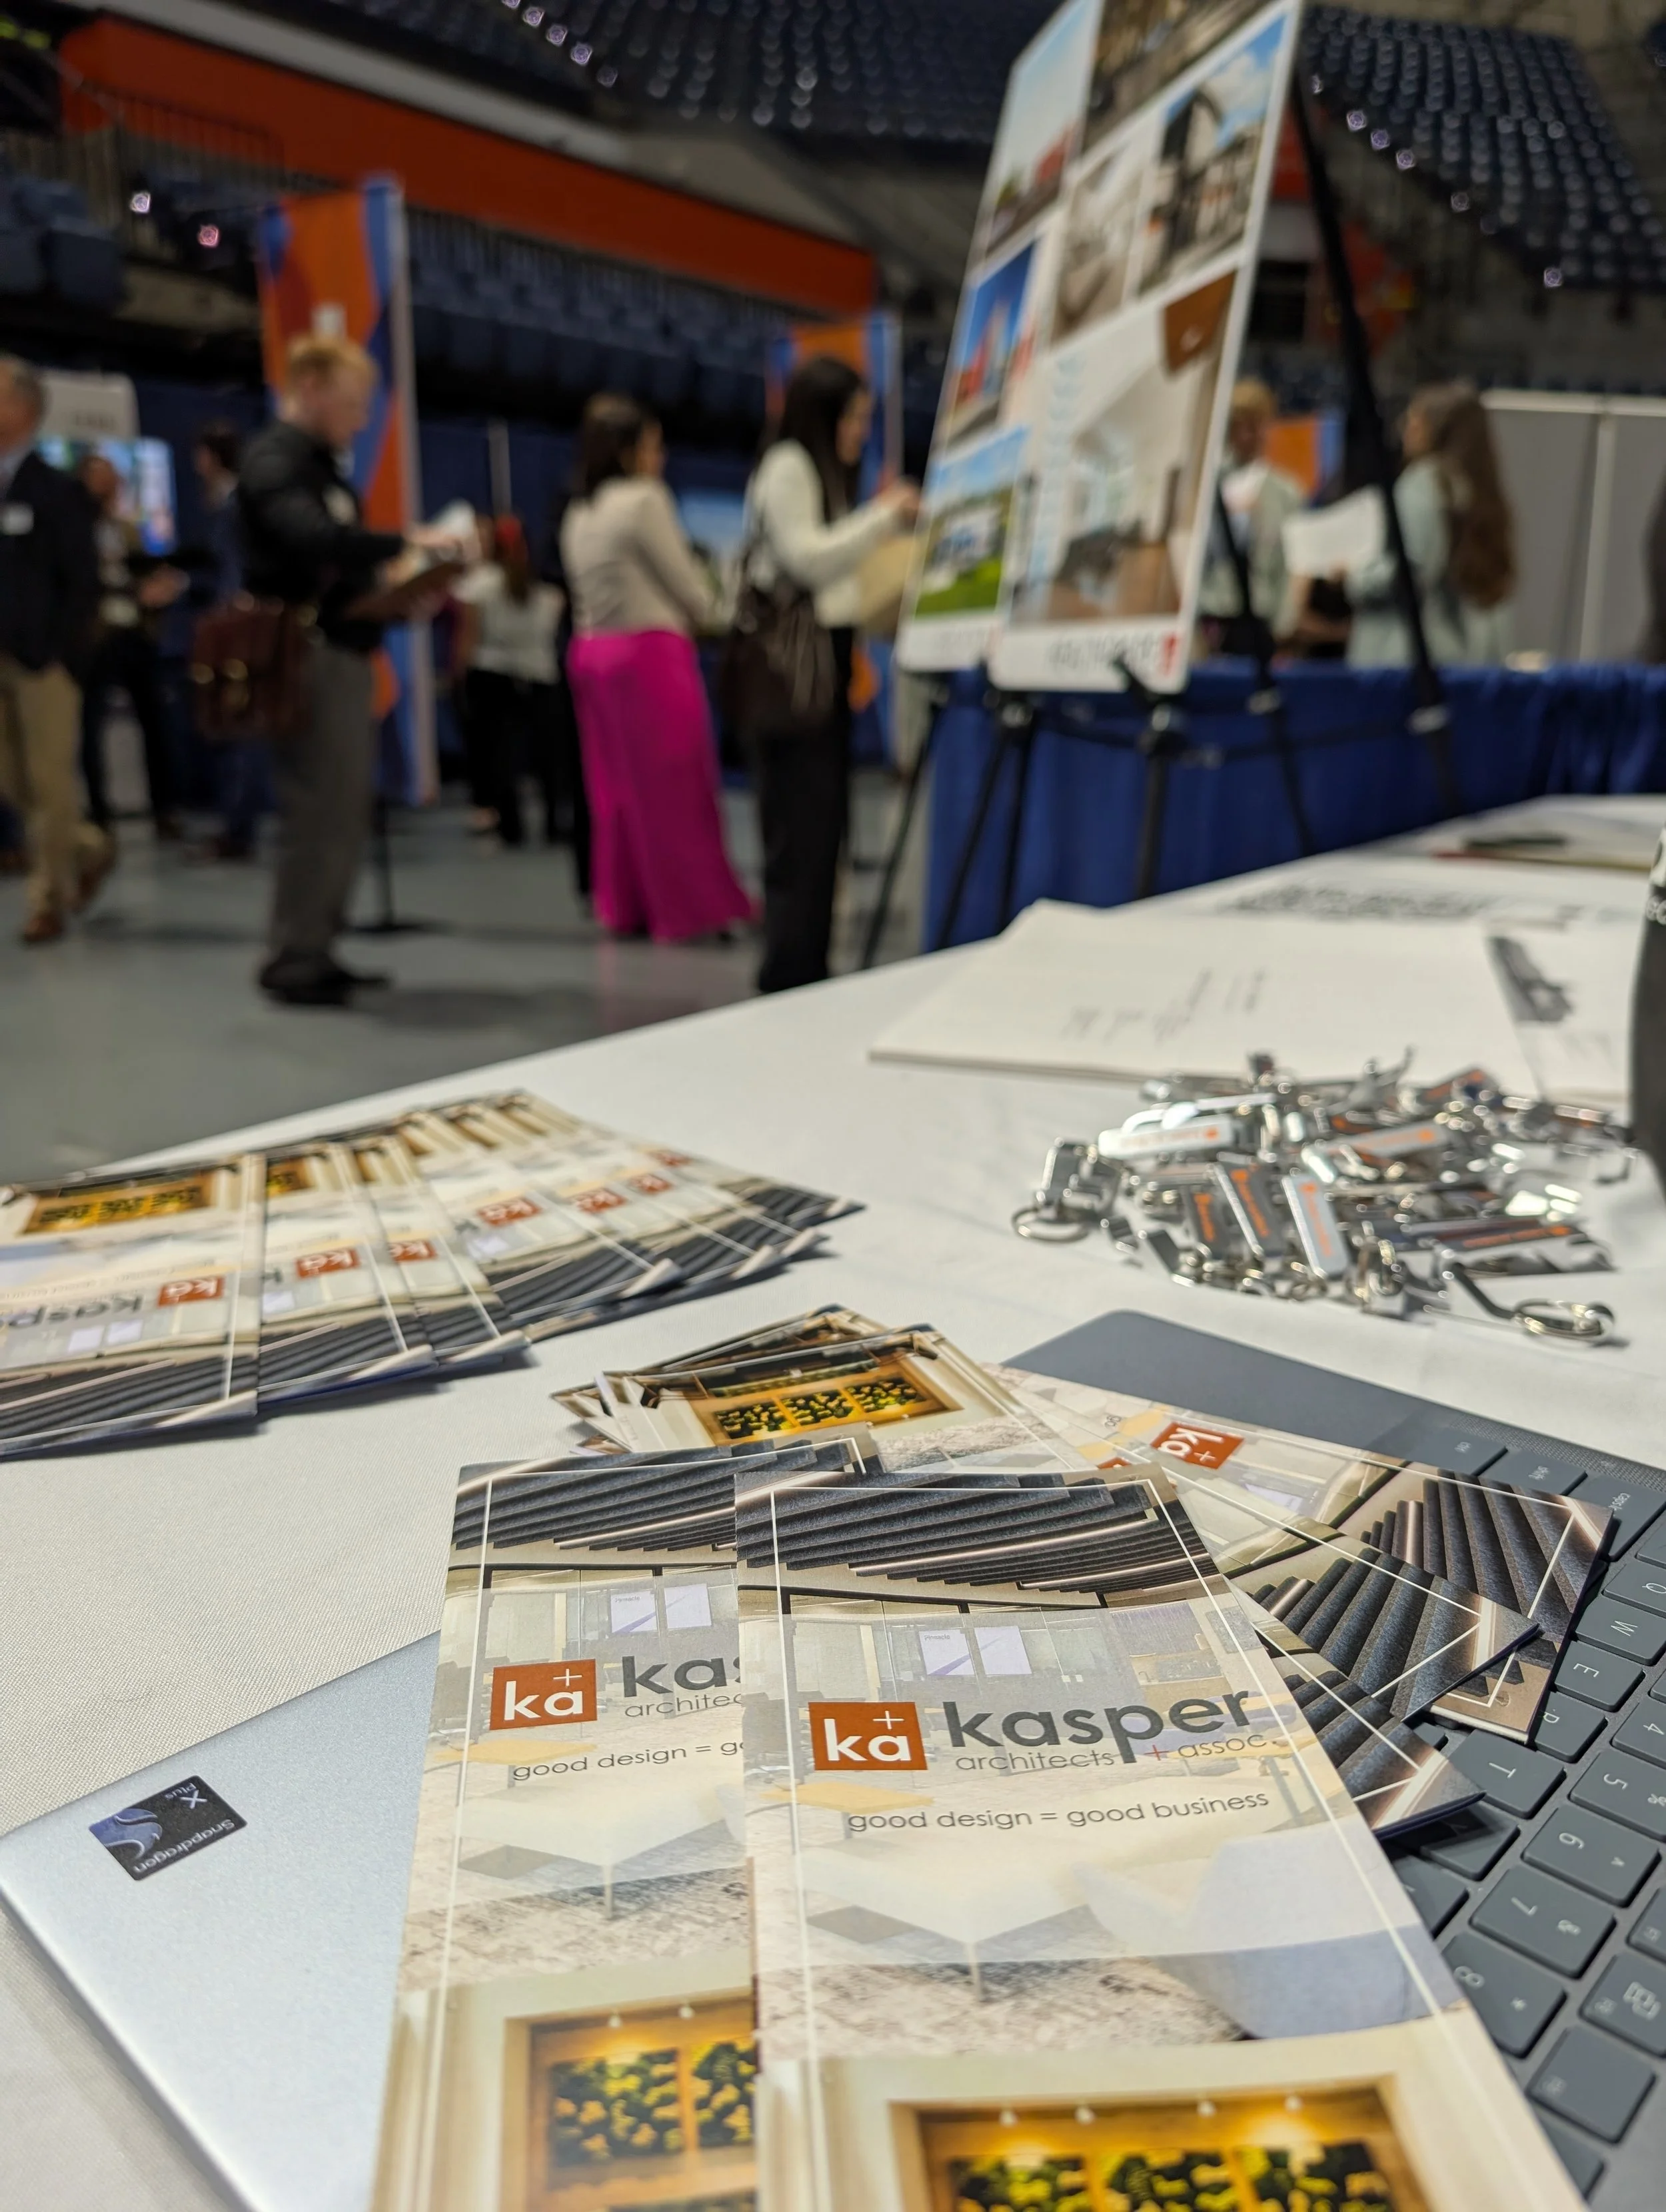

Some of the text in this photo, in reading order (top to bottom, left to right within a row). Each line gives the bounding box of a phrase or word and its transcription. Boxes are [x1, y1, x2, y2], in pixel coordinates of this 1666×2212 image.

[0, 1295, 142, 1327] kasp
[1610, 1620, 1639, 1637] W
[1573, 1662, 1600, 1678] E
[942, 1690, 1250, 1764] kasper
[1643, 1722, 1665, 1736] 4
[956, 1748, 1115, 1771] architects
[1178, 1734, 1278, 1758] assoc.
[512, 1756, 588, 1781] good
[597, 1746, 687, 1769] design
[1488, 1762, 1517, 1779] T
[165, 1782, 197, 1800] Plus
[1603, 1773, 1628, 1790] 5
[180, 1790, 207, 1809] X
[848, 1811, 928, 1832] good
[936, 1808, 1032, 1830] design
[1067, 1802, 1146, 1827] good
[1154, 1789, 1269, 1818] business
[135, 1819, 235, 1873] Snapdragon
[1559, 1832, 1585, 1850] 6
[1511, 1897, 1538, 1916] 7
[1453, 1965, 1485, 1989] 8
